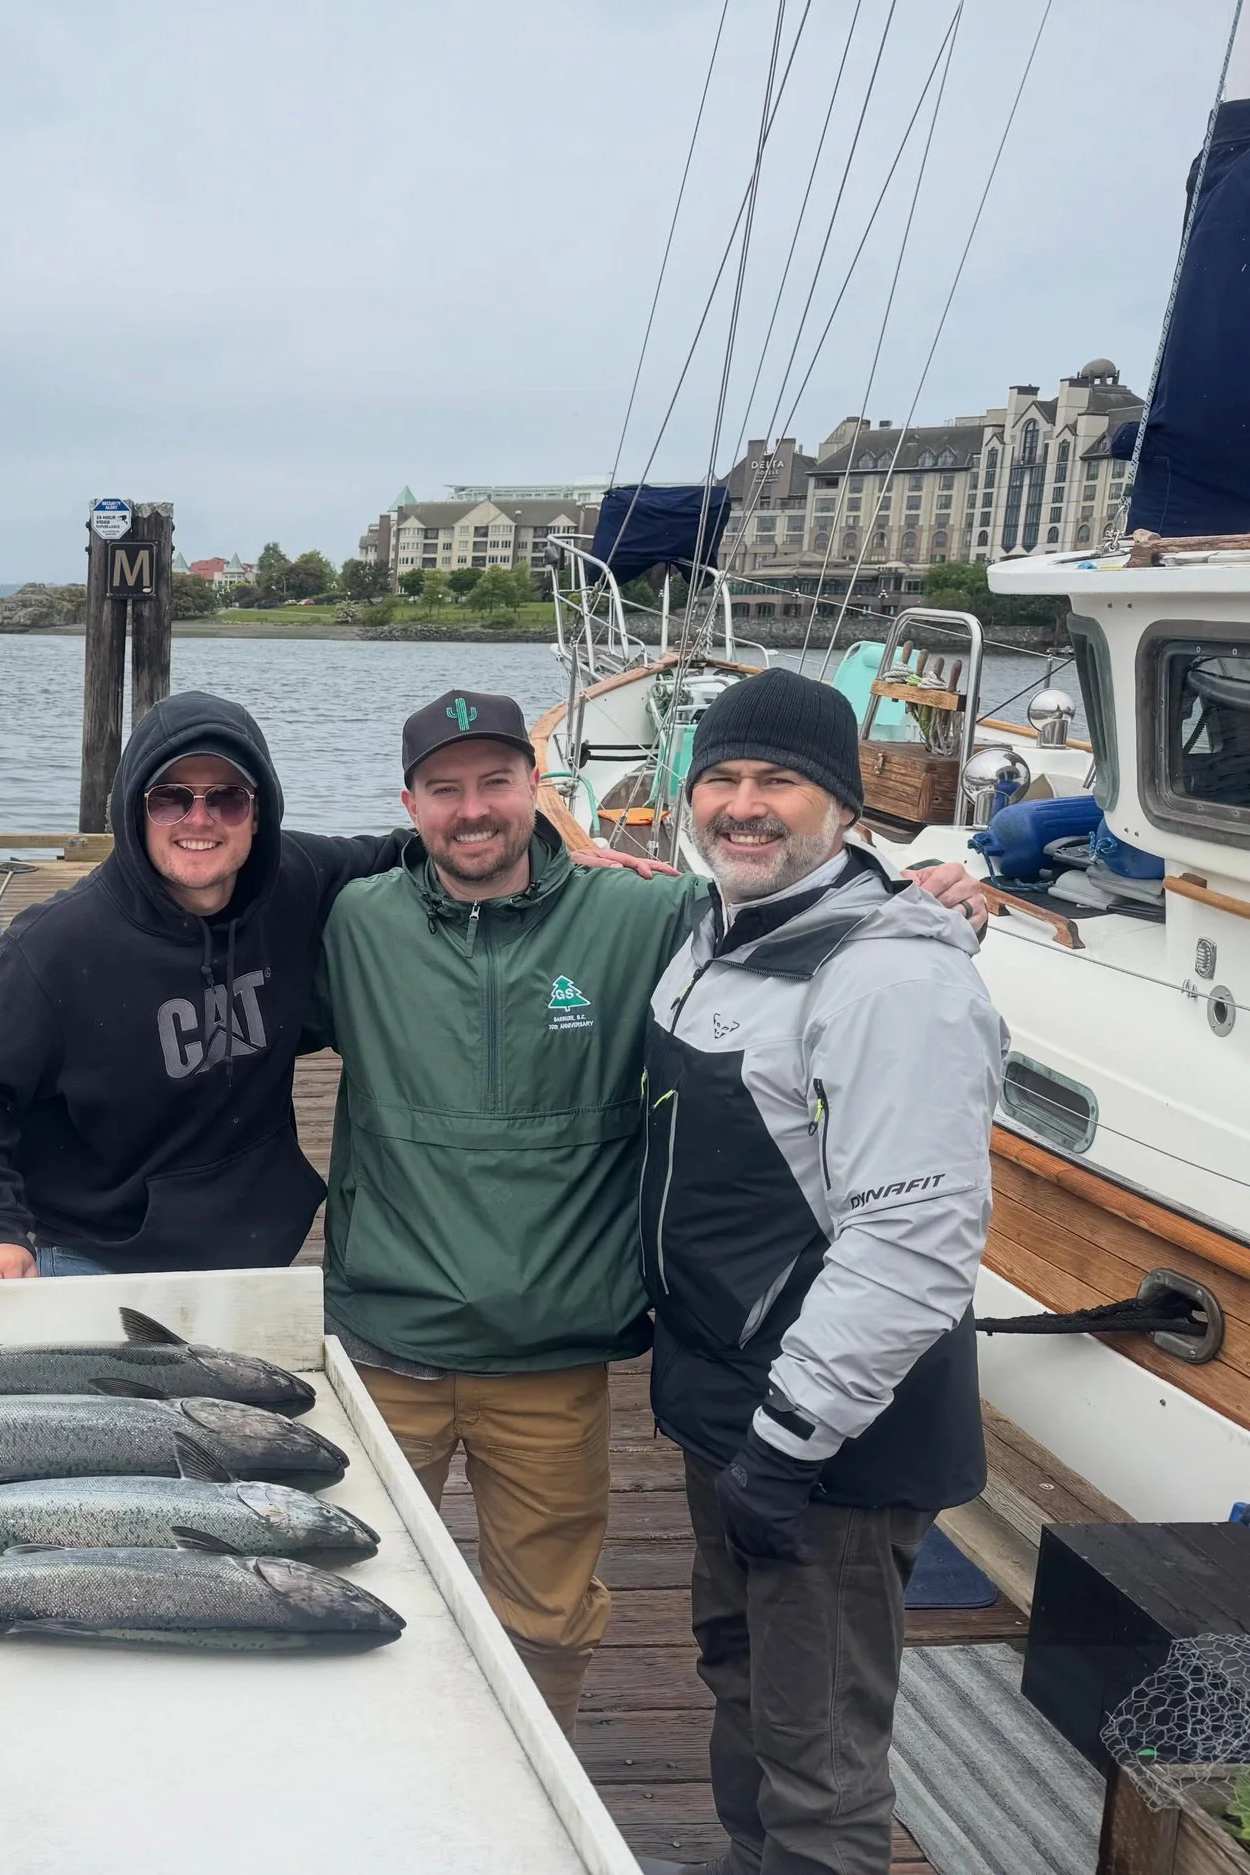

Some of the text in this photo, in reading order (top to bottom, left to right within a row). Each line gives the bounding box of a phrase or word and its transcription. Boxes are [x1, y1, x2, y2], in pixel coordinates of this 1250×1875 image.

[751, 460, 784, 469] DELTA
[112, 549, 150, 587] M
[555, 987, 574, 1000] GS
[157, 970, 267, 1079] CAT
[560, 1020, 594, 1029] ANNIVERSARY
[850, 1173, 946, 1210] DYNAFIT
